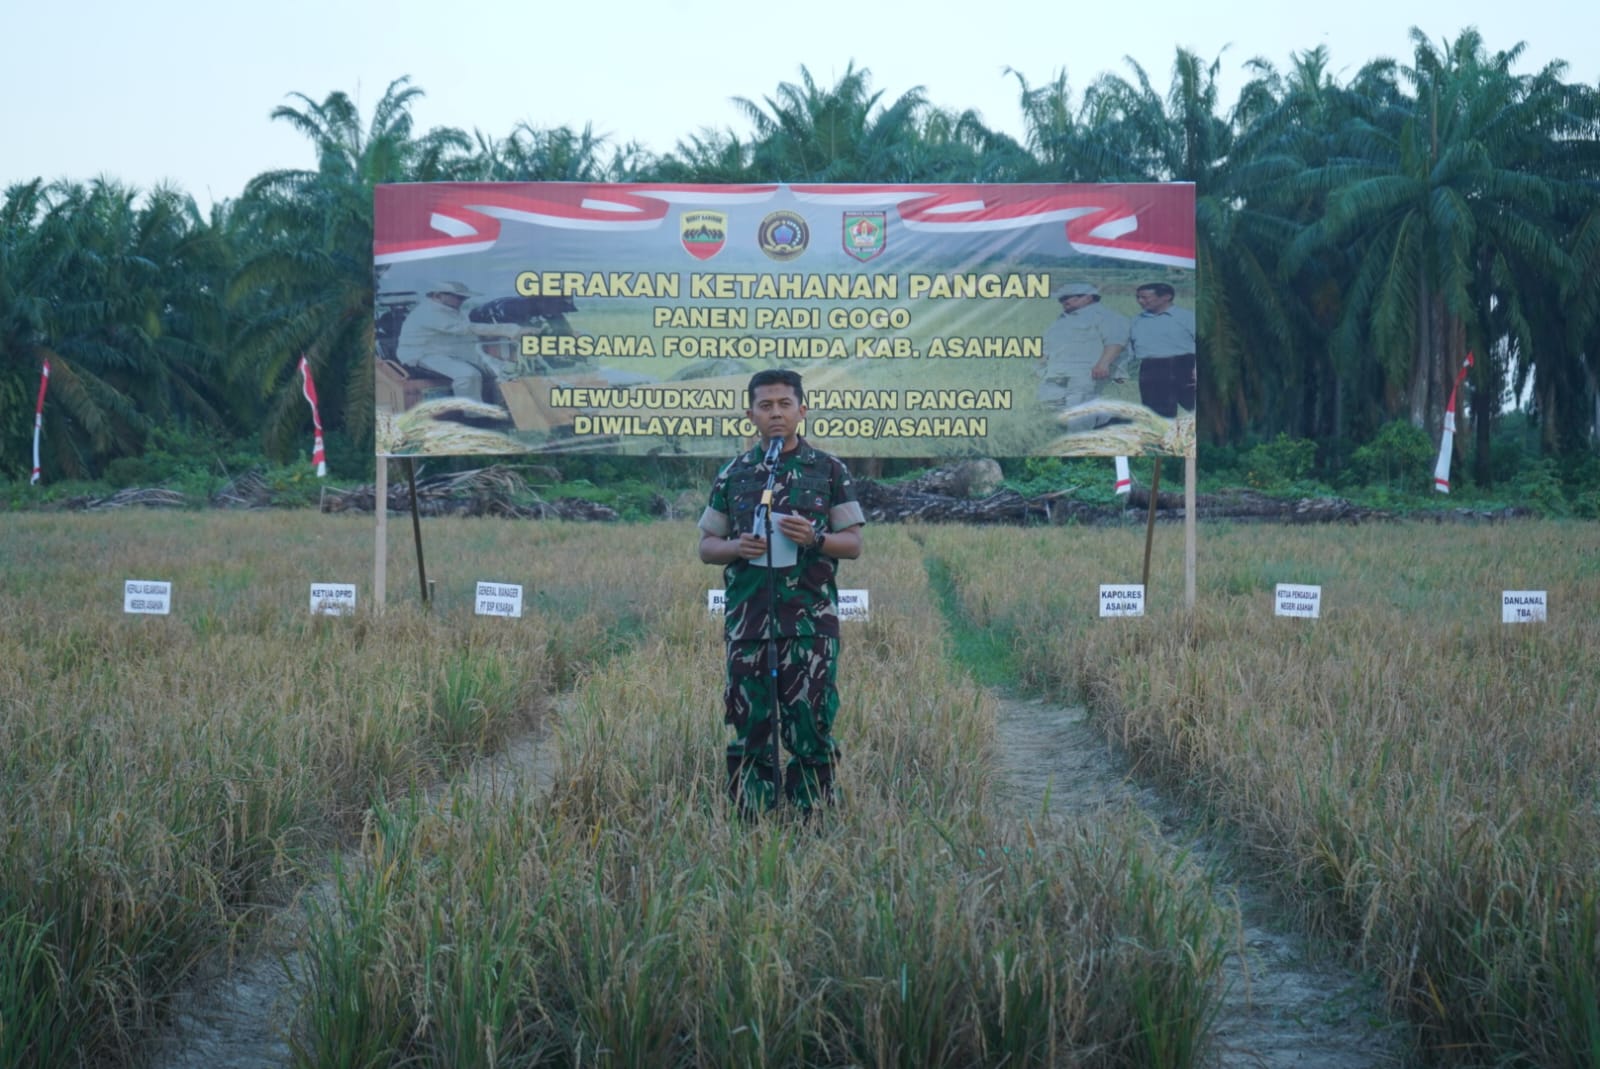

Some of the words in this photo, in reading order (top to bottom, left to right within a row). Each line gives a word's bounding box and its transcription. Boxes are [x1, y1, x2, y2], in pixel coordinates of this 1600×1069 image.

[515, 271, 680, 298] GERAKAN
[690, 272, 898, 299] KETAHANAN
[908, 273, 1051, 299] PANGAN
[653, 306, 748, 329] PANEN
[755, 307, 821, 329] PADI
[827, 307, 911, 330] GOGO
[521, 335, 656, 358] BERSAMA
[662, 336, 849, 359] FORKOPIMDA
[855, 337, 921, 359] KAB.
[927, 337, 1043, 359] ASAHAN
[550, 387, 735, 410] MEWUJUDKAN
[905, 390, 1013, 410] PANGAN
[573, 416, 714, 437] DIWILAYAH
[812, 417, 988, 439] 0208/ASAHAN
[312, 589, 333, 598] KETUA
[335, 589, 353, 599] DPRD
[479, 585, 497, 597] GENERAL
[498, 587, 518, 598] MANAGER
[1101, 590, 1142, 599] KAPOLRES
[1278, 590, 1291, 599] KETUA
[1292, 590, 1318, 600] PENGADILAN
[1280, 601, 1296, 610] NEGERI
[1296, 603, 1313, 611] ASAHAN
[1504, 596, 1544, 605] DANLANAL
[480, 601, 486, 610] PT
[496, 602, 514, 613] KISARAN
[1105, 602, 1138, 611] ASAHAN
[1516, 609, 1531, 617] TBA
